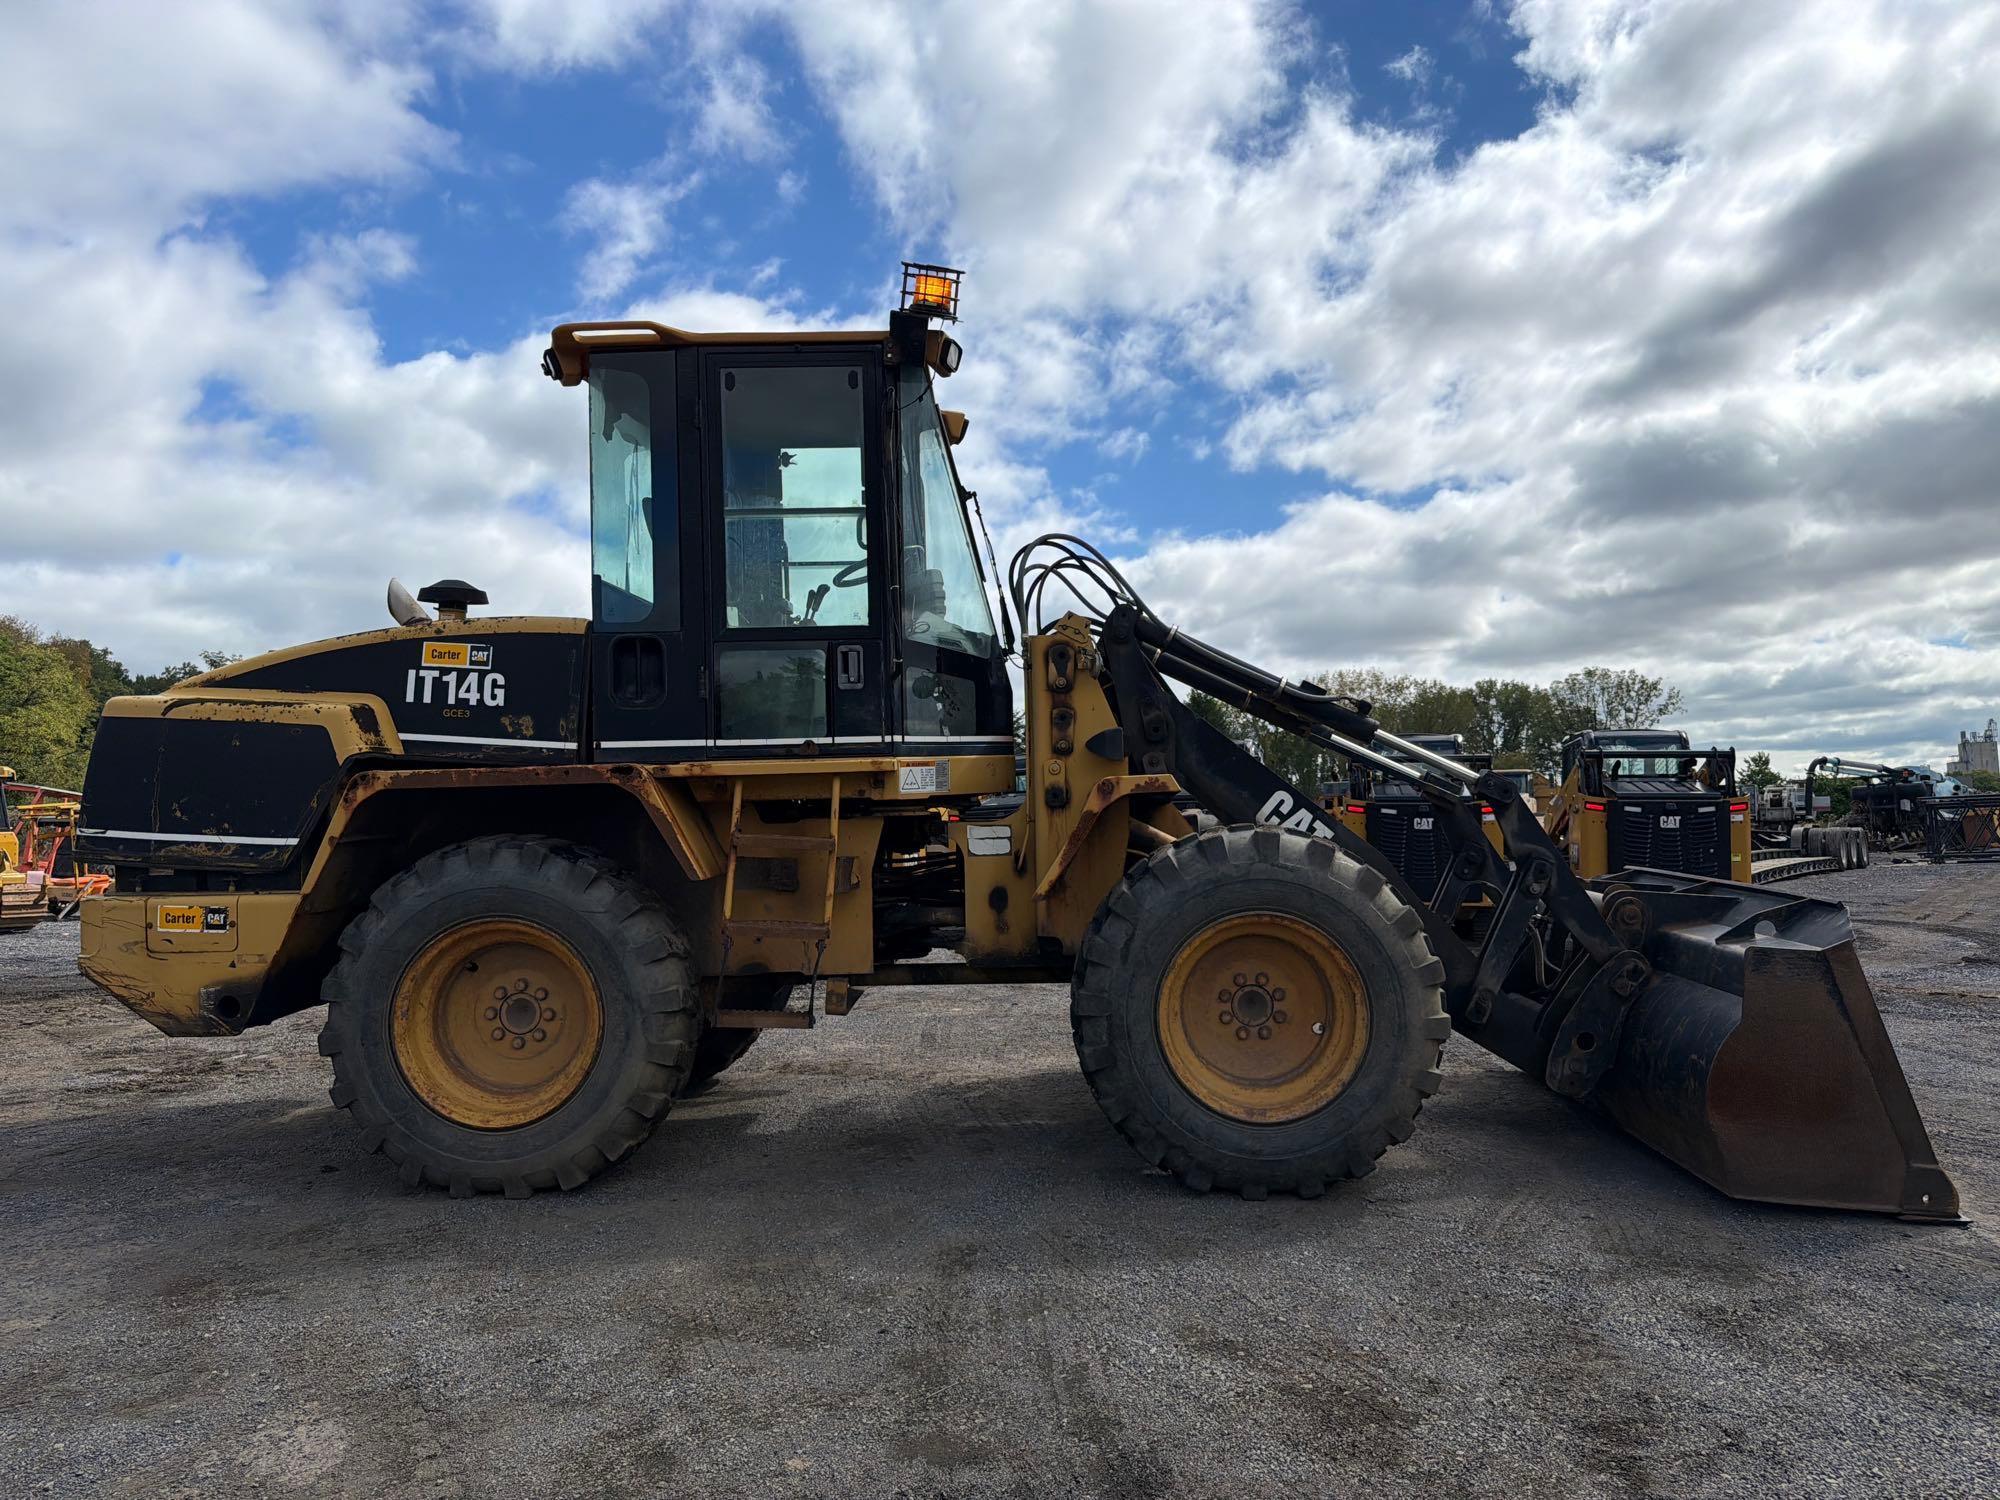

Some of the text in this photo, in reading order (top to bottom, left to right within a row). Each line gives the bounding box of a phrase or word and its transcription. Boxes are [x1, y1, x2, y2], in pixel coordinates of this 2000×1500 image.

[431, 649, 489, 661] Carter CAT
[405, 669, 505, 707] IT14G
[442, 709, 470, 718] GCE3
[1413, 817, 1434, 830] CAT
[1660, 816, 1681, 829] CAT
[164, 912, 225, 925] Carter CAT
